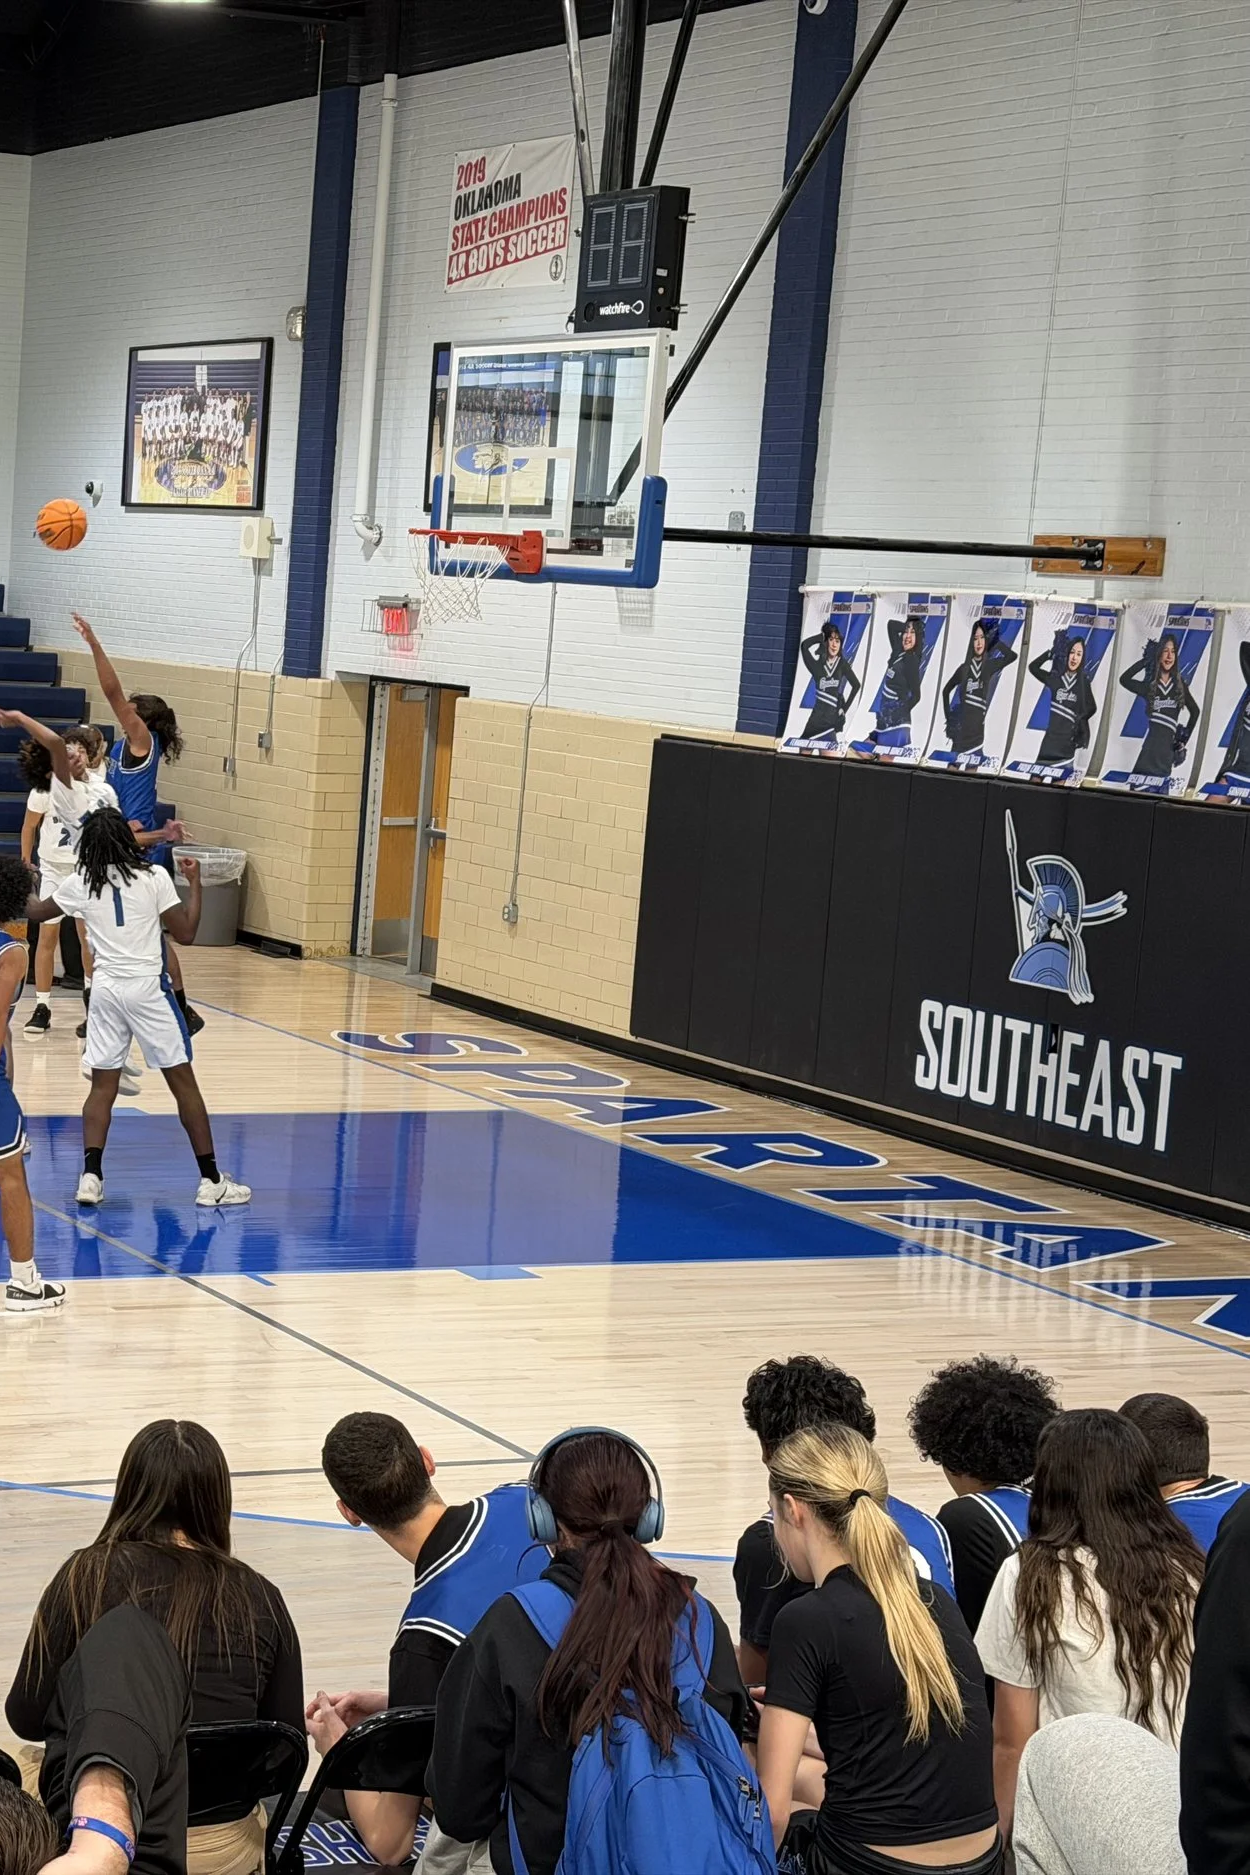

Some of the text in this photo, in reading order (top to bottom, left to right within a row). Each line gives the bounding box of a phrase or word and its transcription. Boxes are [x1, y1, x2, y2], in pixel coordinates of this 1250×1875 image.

[456, 156, 487, 191] 2019
[454, 172, 522, 221] OKLAHOMA
[451, 187, 567, 252] STATE CHAMPIONS
[468, 239, 505, 275] BOYS
[507, 218, 566, 262] SOCCER
[599, 301, 630, 316] watchfire
[111, 887, 125, 928] 1
[914, 999, 1184, 1152] SOUTHEAST
[1020, 1475, 1035, 1487] NIK
